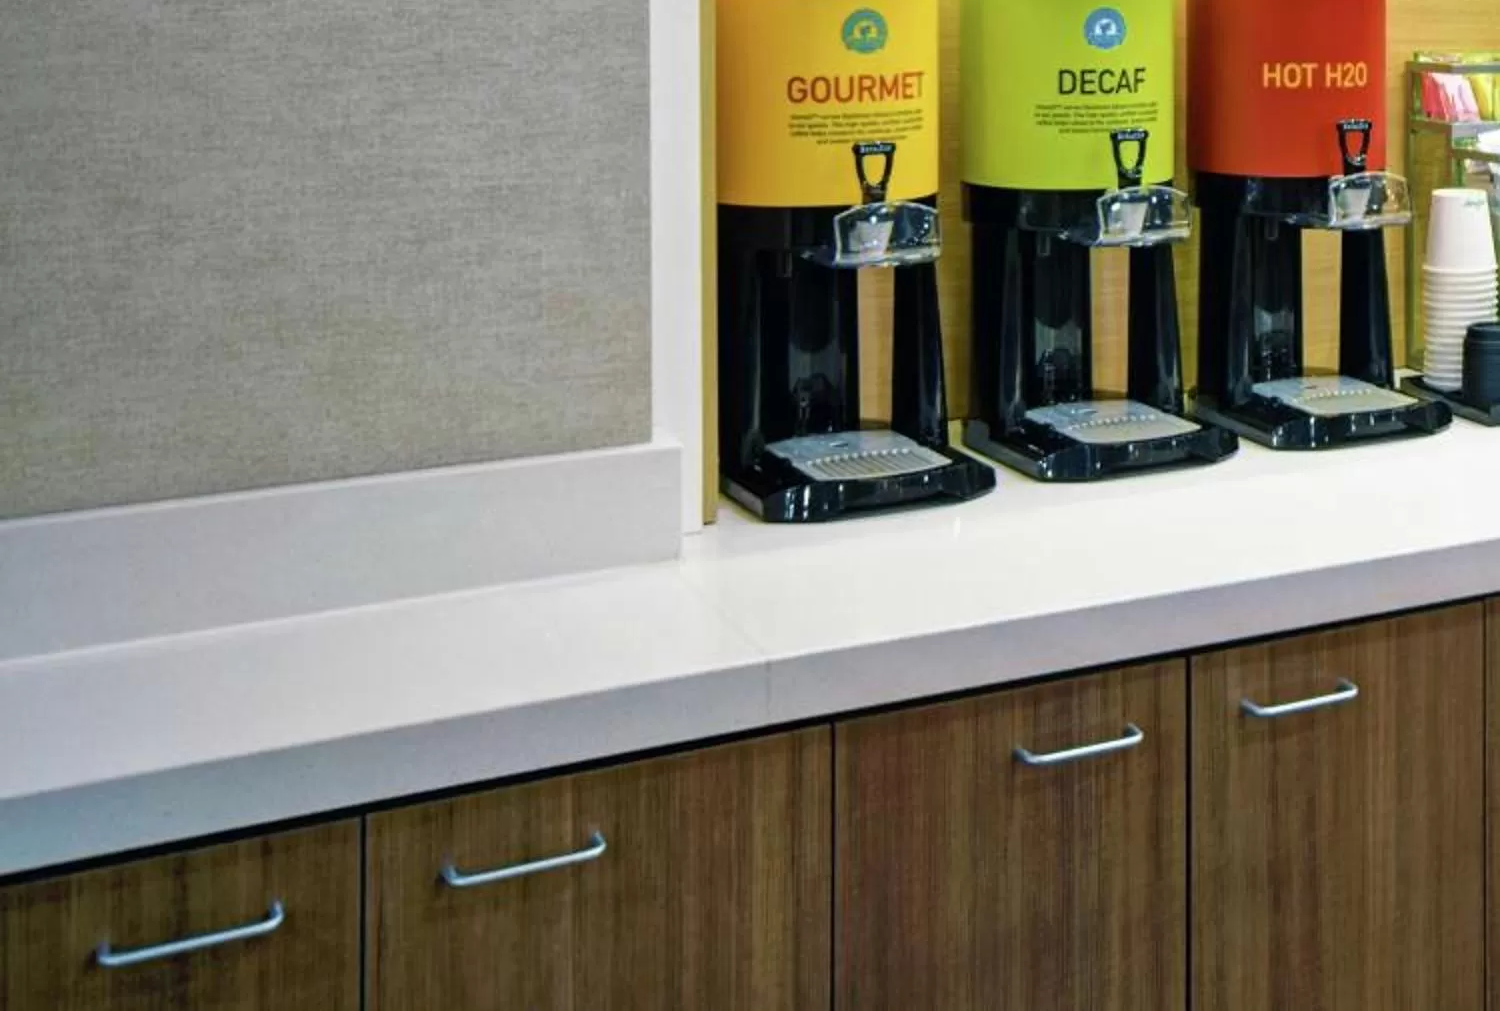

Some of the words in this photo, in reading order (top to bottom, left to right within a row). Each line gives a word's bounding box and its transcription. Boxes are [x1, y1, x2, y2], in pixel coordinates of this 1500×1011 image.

[787, 71, 925, 104] GOURMET
[1058, 67, 1146, 94] DECAF
[1263, 62, 1319, 89] HOT
